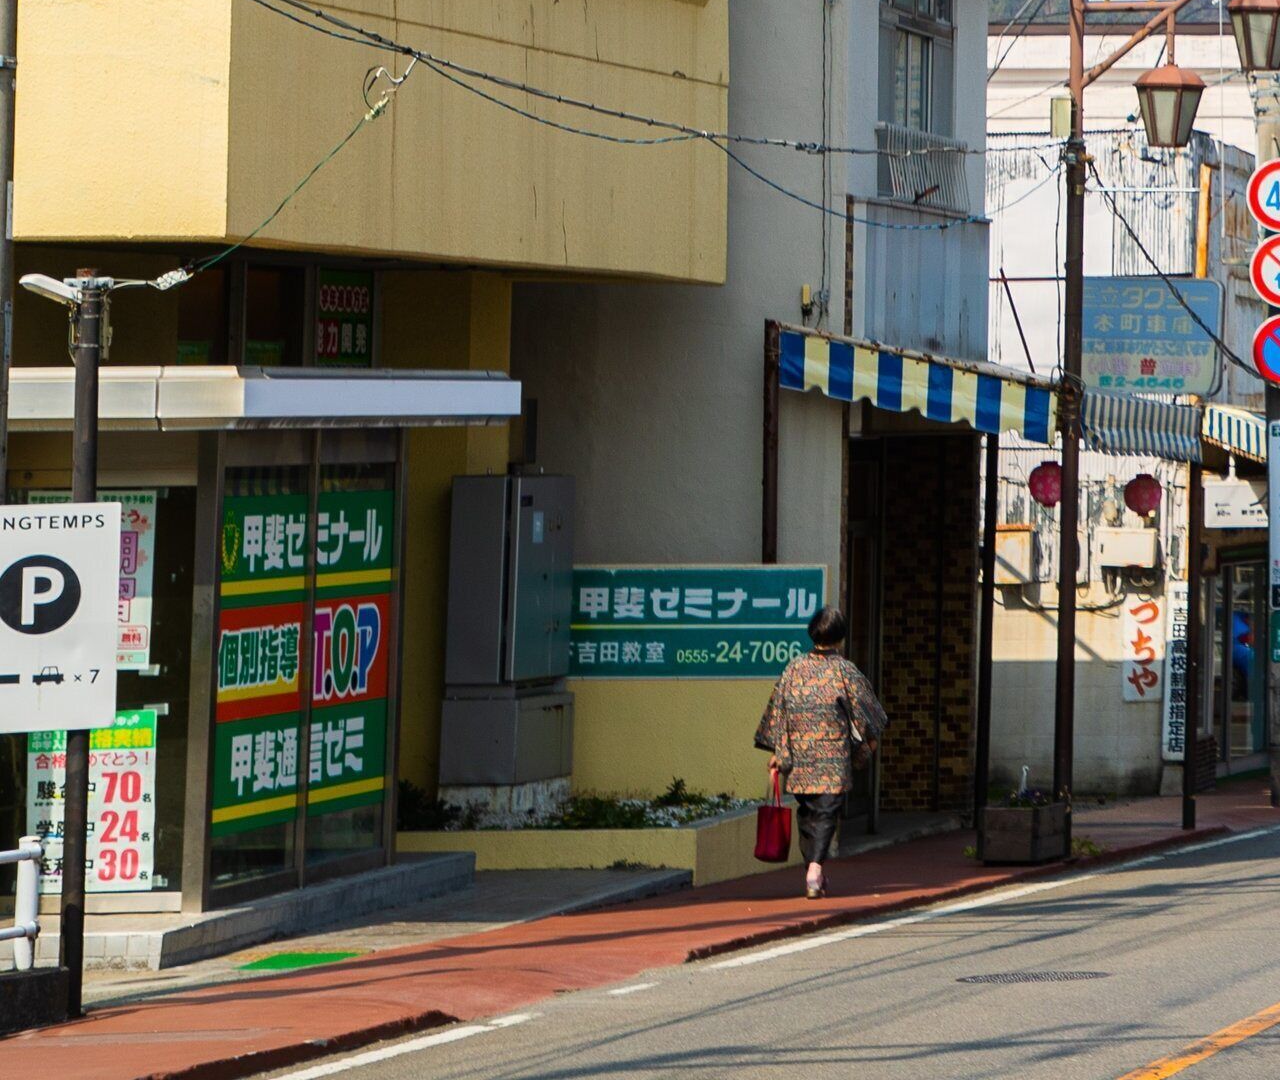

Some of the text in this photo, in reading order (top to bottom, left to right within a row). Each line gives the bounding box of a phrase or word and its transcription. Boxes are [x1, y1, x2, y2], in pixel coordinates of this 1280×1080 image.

[3, 514, 105, 531] NGTEMPS
[242, 508, 384, 573] 甲斐ゼミナール
[21, 565, 65, 627] P
[579, 586, 817, 619] 甲斐ゼミナール
[218, 622, 301, 691] 個別指導
[569, 640, 803, 664] 吉田教室 0555-24-7066
[1128, 602, 1160, 698] つちや
[90, 670, 100, 684] 7
[90, 728, 152, 749] 格実績
[230, 717, 364, 796] 甲斐通信ゼミ
